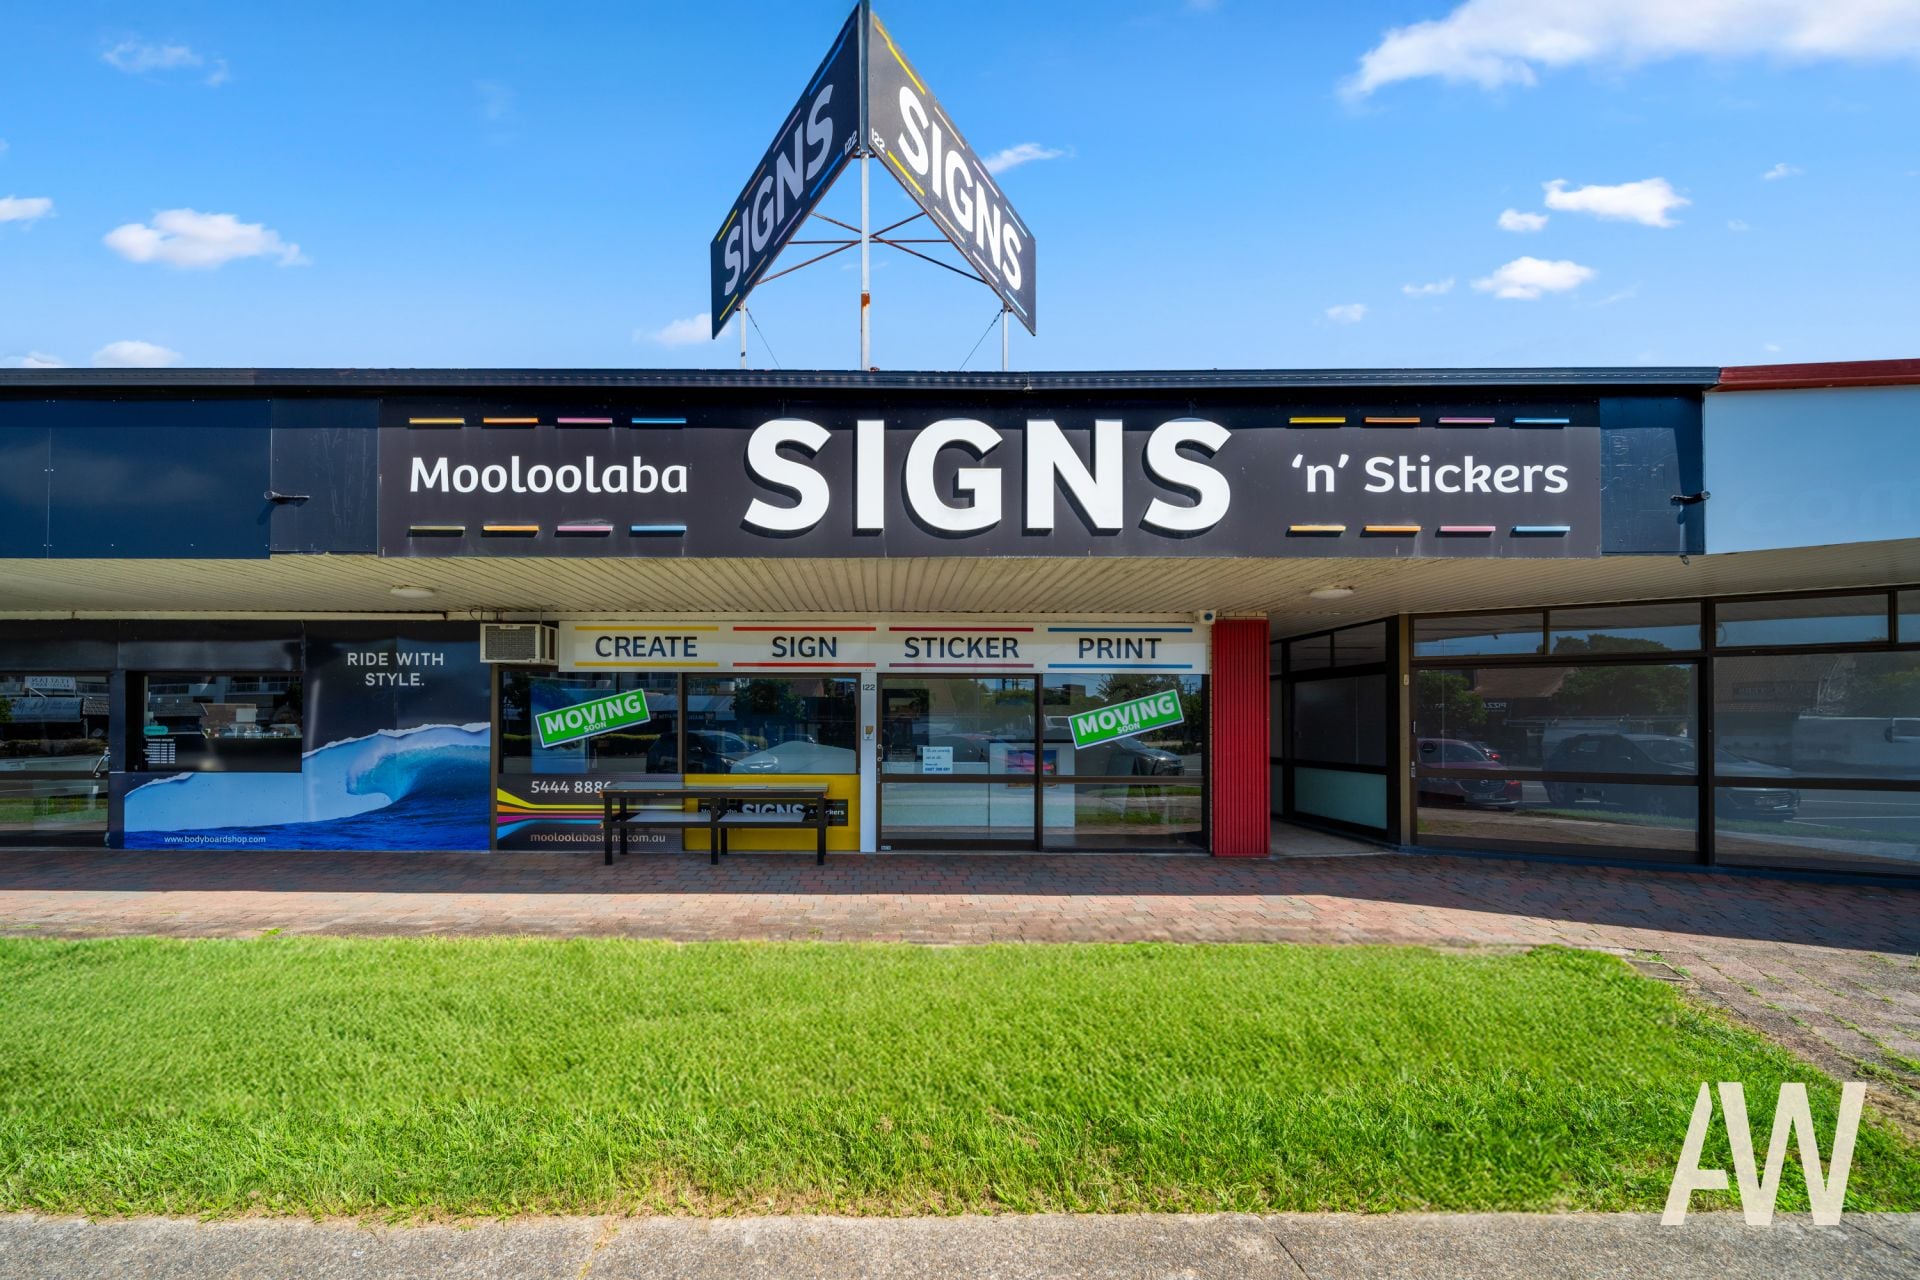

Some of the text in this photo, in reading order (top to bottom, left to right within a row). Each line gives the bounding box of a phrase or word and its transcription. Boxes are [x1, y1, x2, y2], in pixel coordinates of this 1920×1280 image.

[844, 130, 857, 156] 122
[871, 127, 885, 153] 122
[725, 84, 833, 296] SIGNS
[899, 86, 1022, 290] SIGNS
[410, 456, 687, 493] Mooloolaba
[741, 417, 1232, 536] SIGNS
[1364, 455, 1569, 493] Stickers
[595, 636, 697, 657] CREATE
[772, 636, 837, 658] SIGN
[904, 637, 1019, 658] STICKER
[1079, 637, 1162, 659] PRINT
[347, 653, 444, 666] RIDE WITH
[365, 673, 425, 686] STYLE.
[862, 683, 876, 691] 122
[544, 695, 641, 735] MOVING
[1077, 695, 1175, 736] MOVING
[583, 721, 607, 733] SOON
[1117, 722, 1141, 734] SOON
[531, 781, 570, 794] 5444
[164, 835, 266, 845] www.bodyboardshop.com
